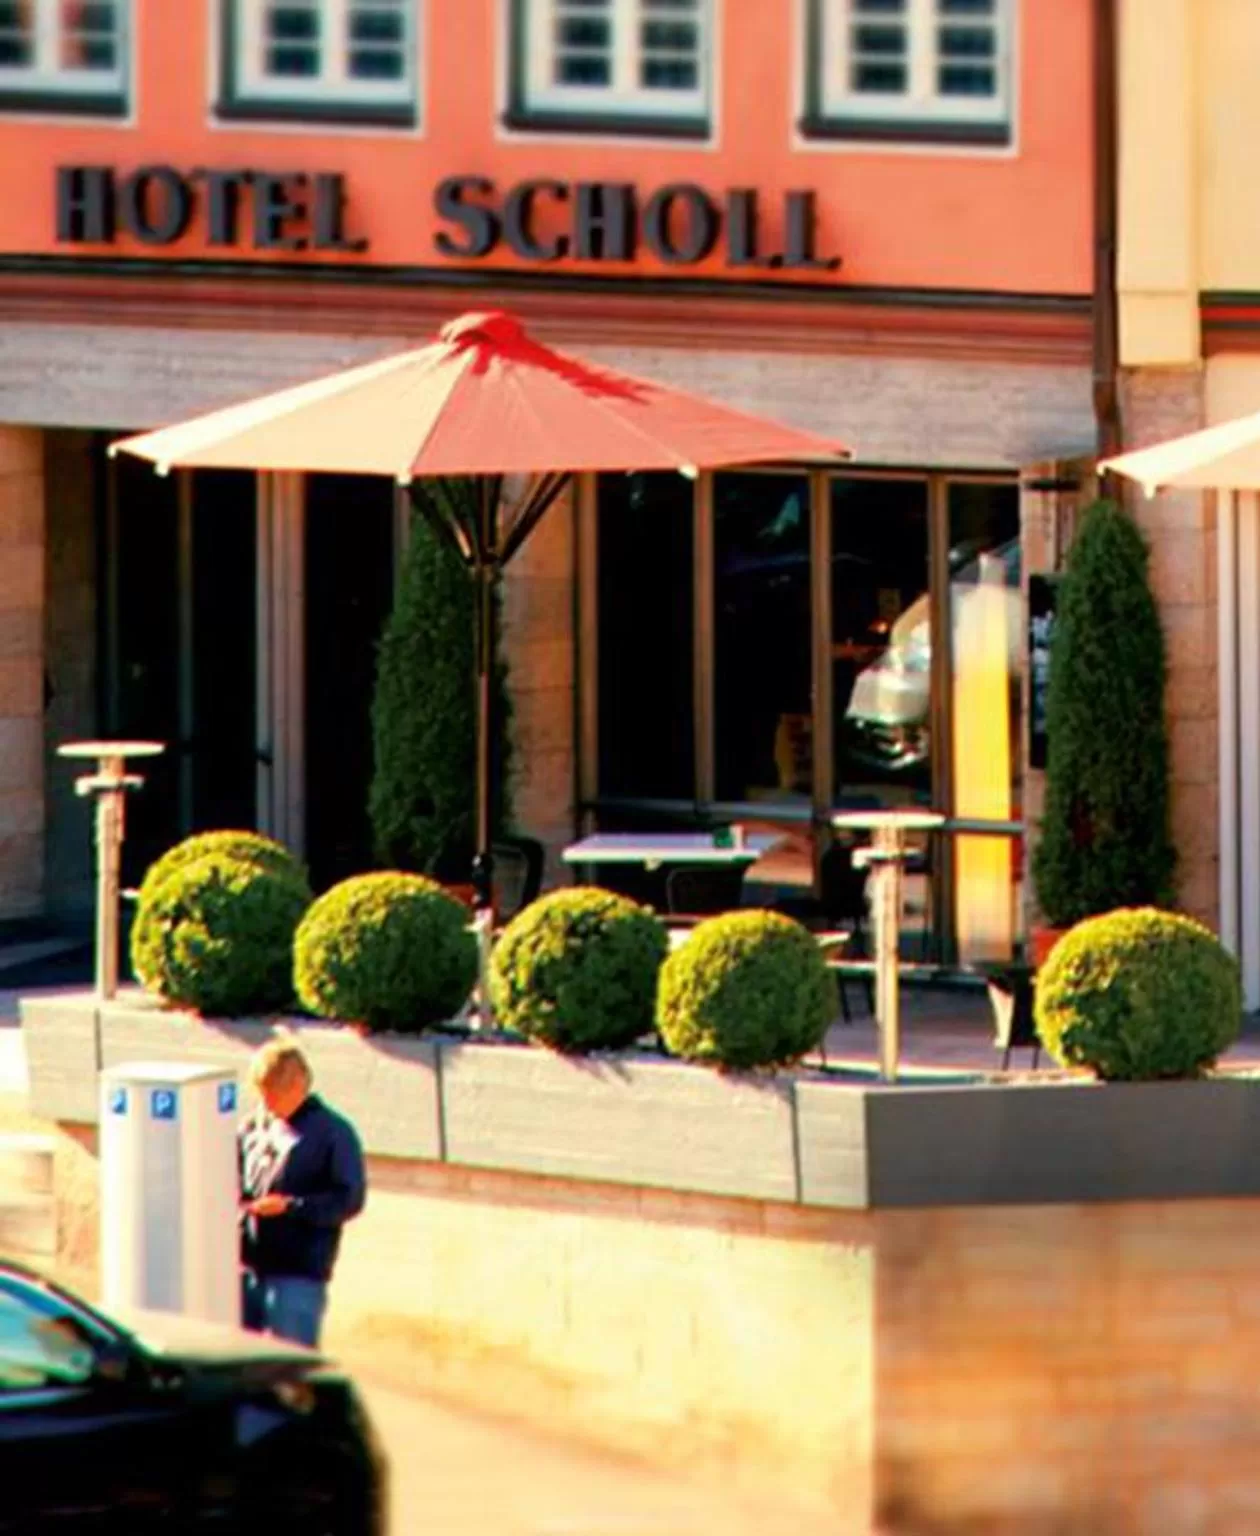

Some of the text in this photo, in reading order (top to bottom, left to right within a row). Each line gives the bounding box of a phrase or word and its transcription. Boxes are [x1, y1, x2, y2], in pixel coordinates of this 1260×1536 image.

[55, 164, 842, 270] HOTEL SCHOLL
[154, 1090, 173, 1115] P
